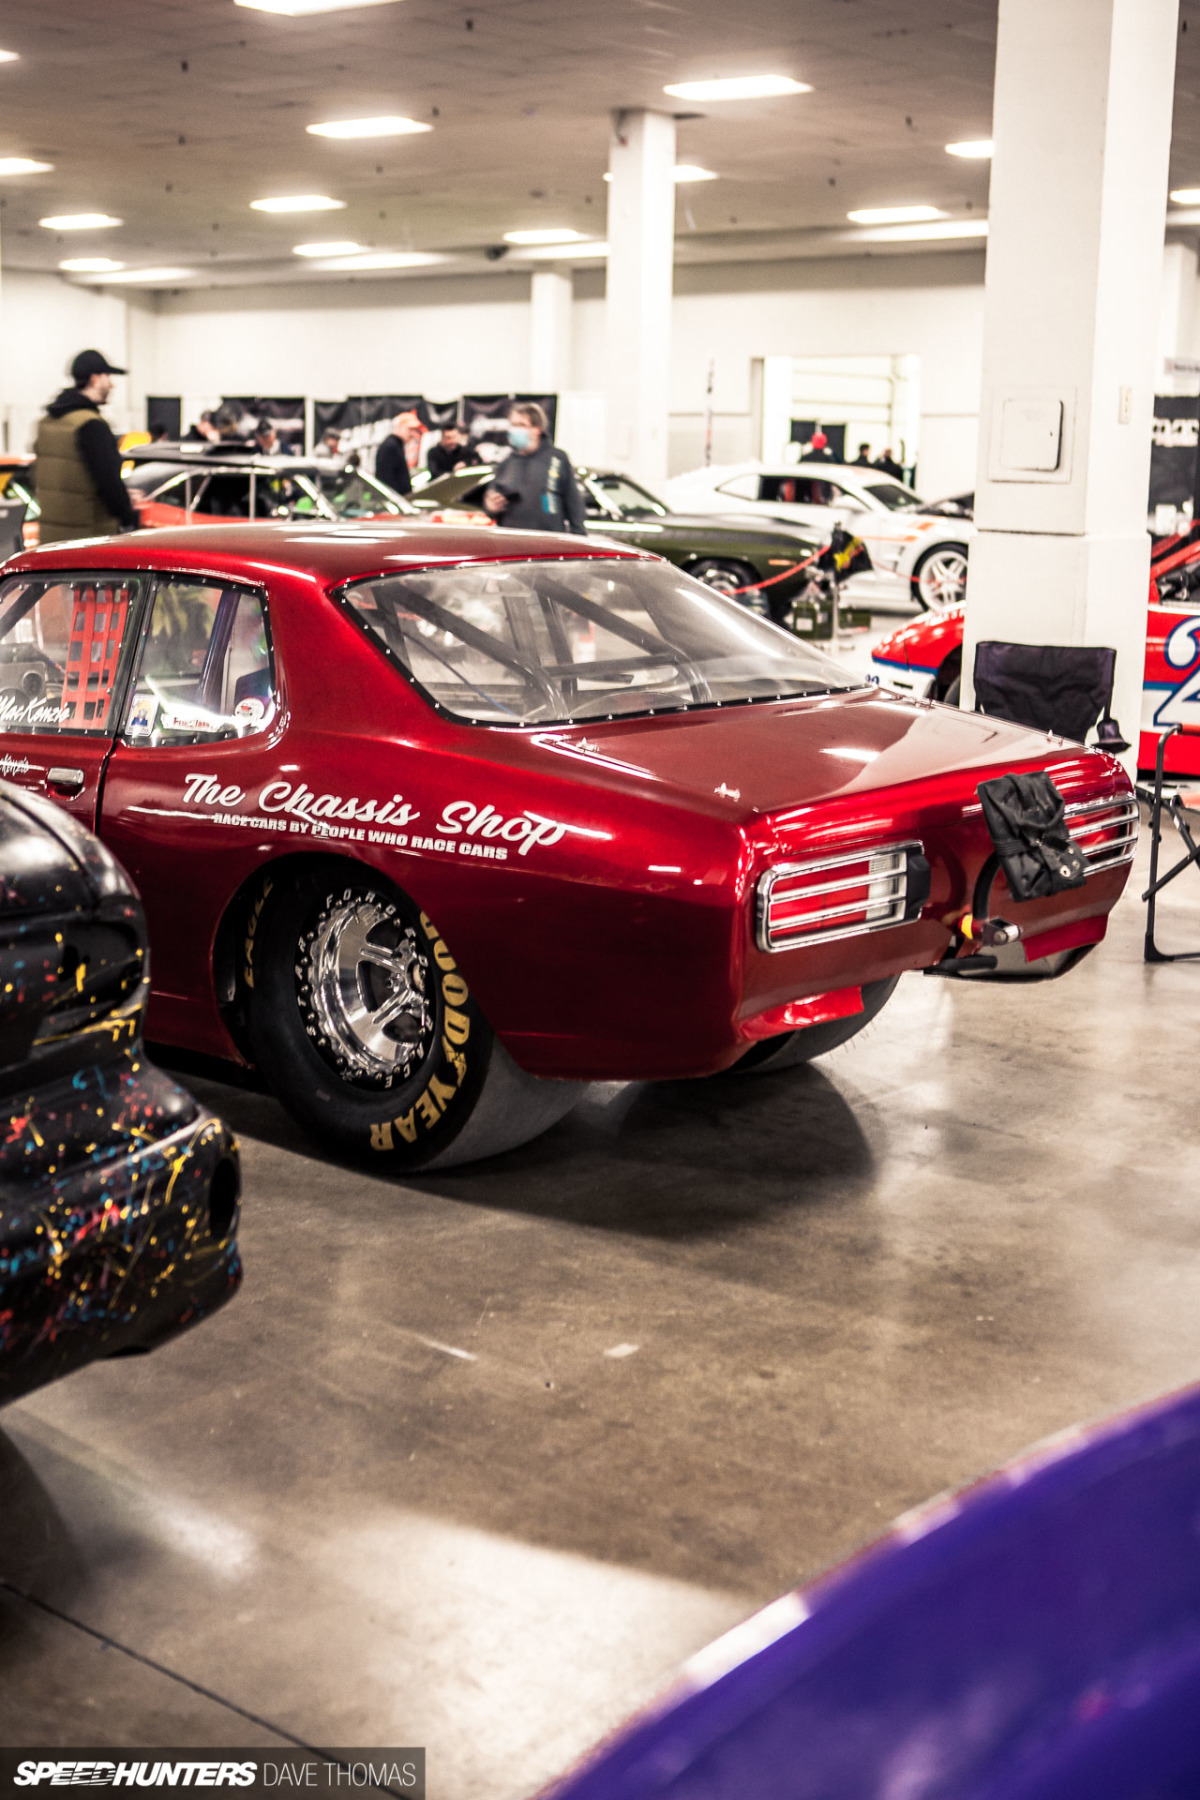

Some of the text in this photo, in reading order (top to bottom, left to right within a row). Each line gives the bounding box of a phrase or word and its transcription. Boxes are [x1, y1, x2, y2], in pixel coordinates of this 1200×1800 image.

[183, 773, 566, 856] The Chassis Shop
[214, 813, 508, 860] RACE CARS BY PEOPLE WHO RACE CARS
